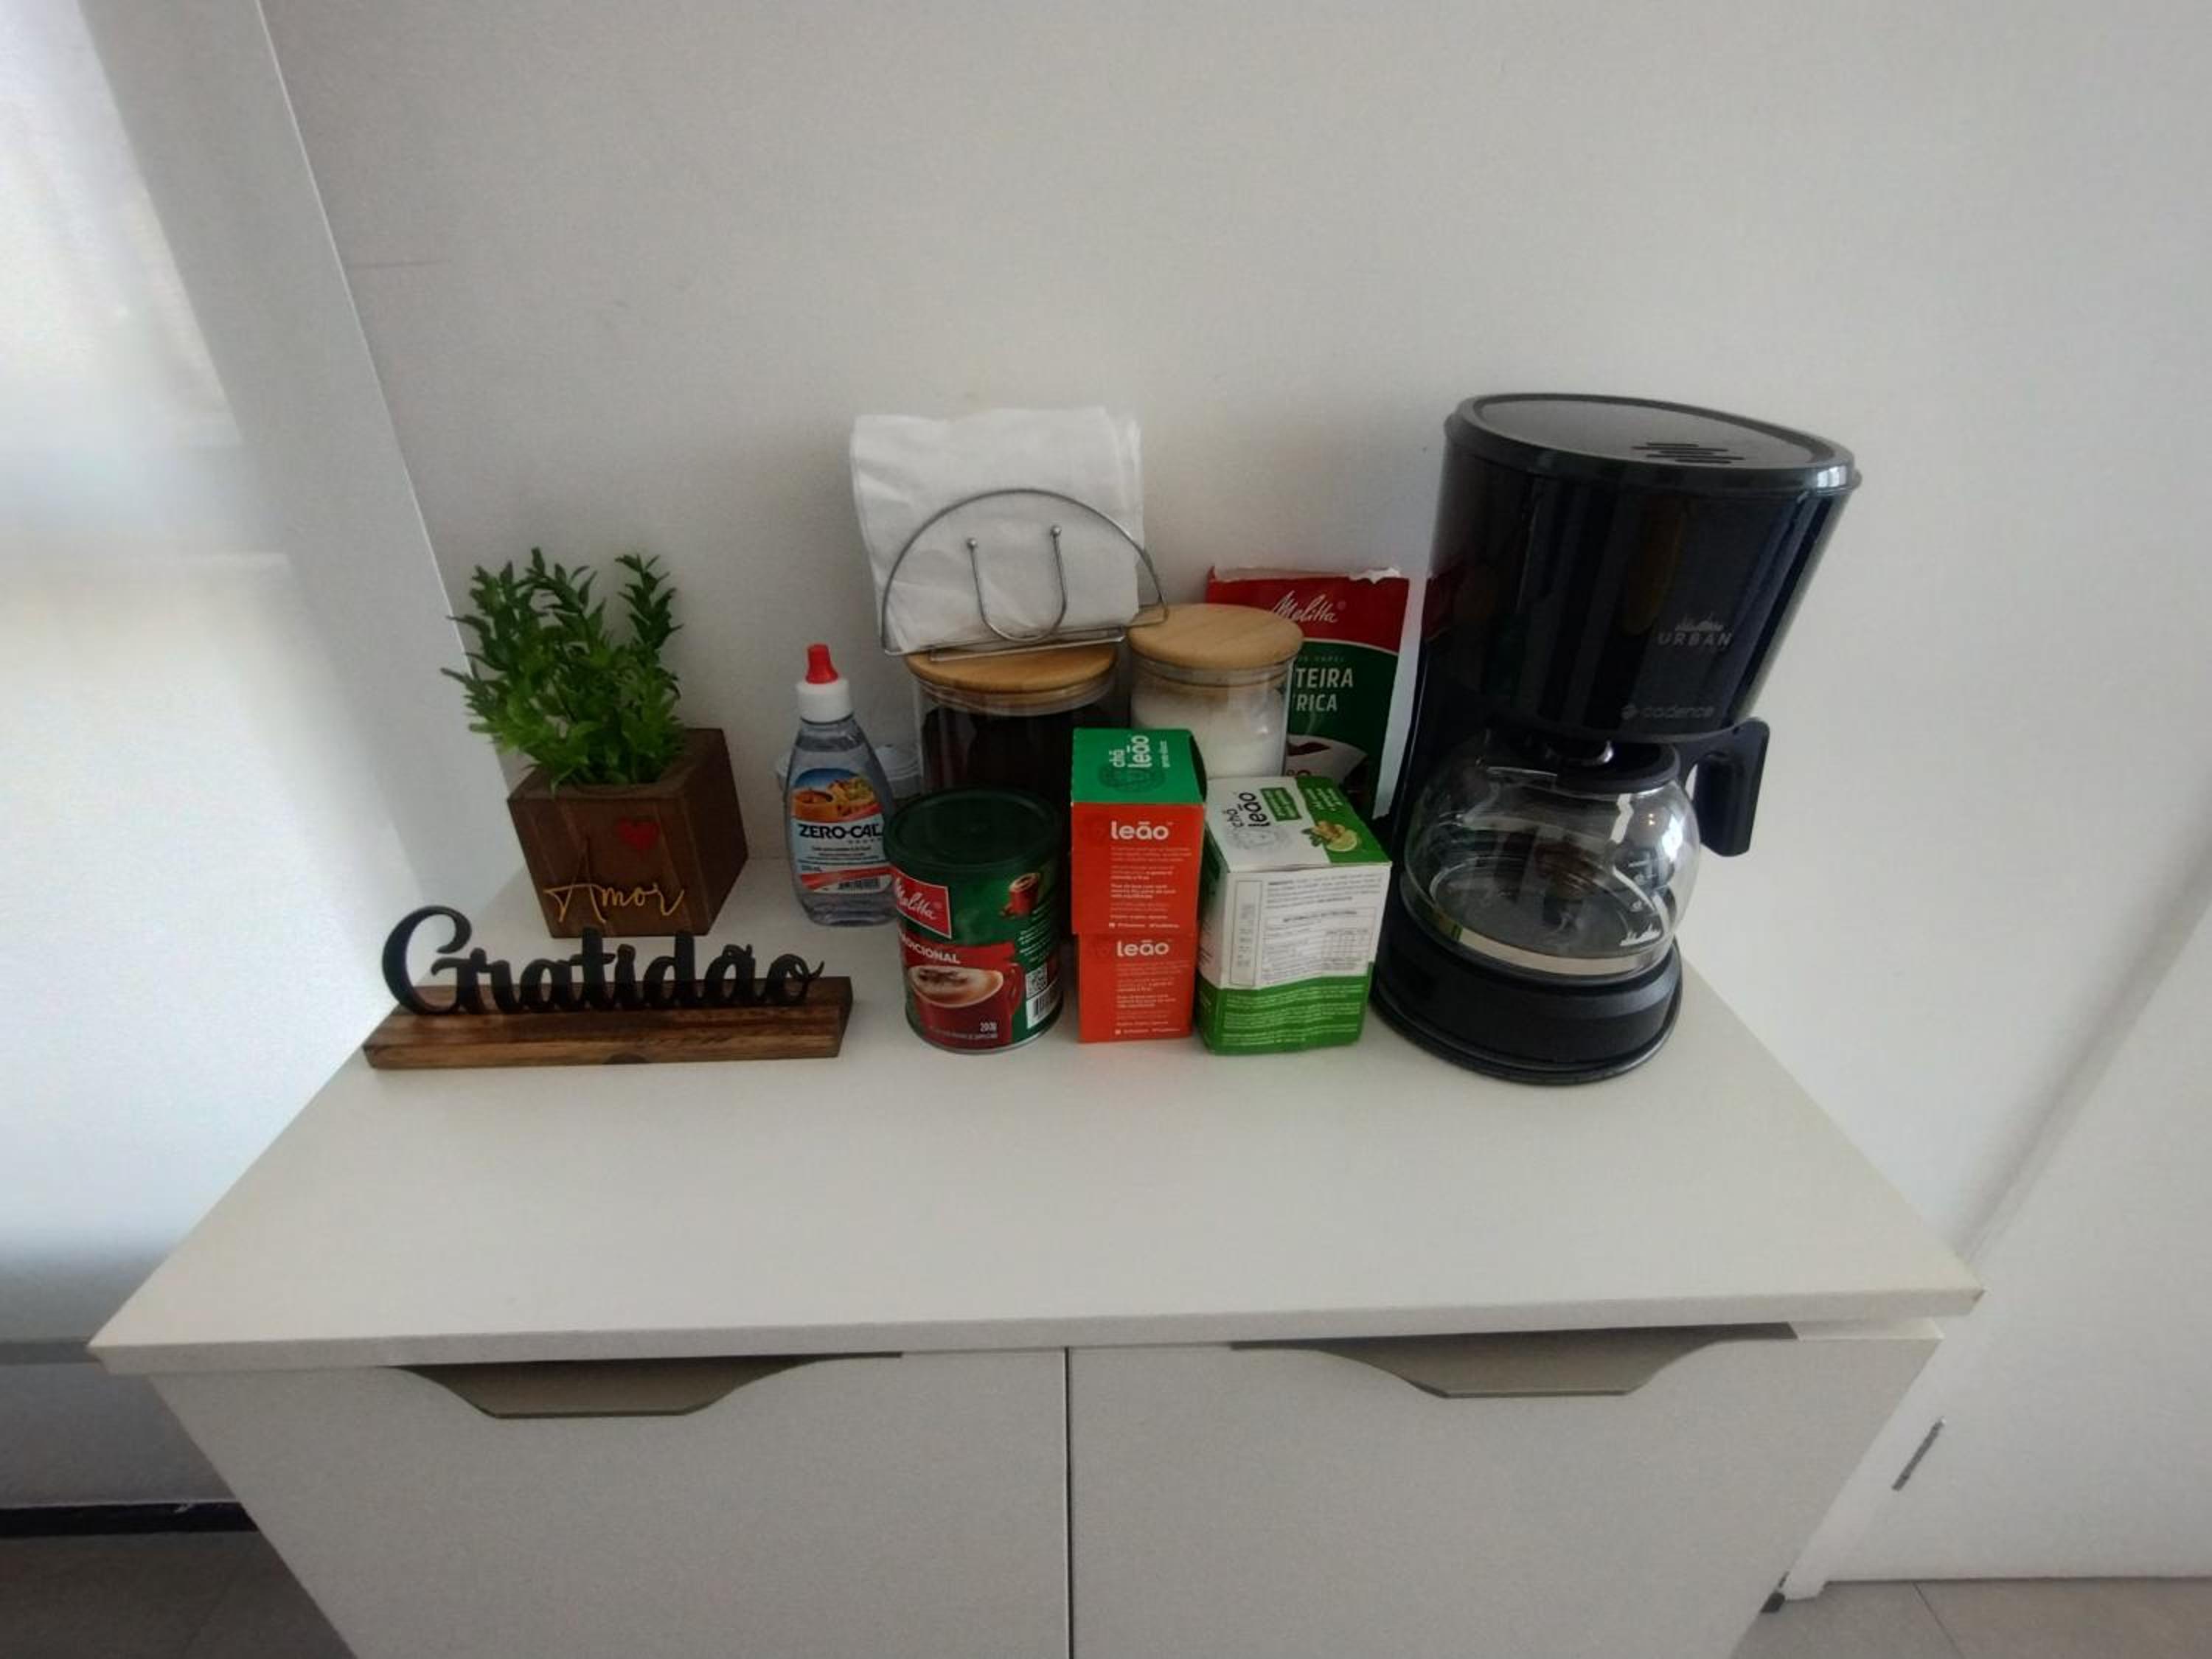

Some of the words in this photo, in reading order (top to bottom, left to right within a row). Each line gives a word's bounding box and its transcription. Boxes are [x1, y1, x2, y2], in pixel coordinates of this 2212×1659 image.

[1273, 590, 1338, 623] Melitta
[1658, 632, 1733, 647] URBAN
[1295, 667, 1354, 689] TEIRA
[1127, 735, 1153, 768] leão
[1237, 791, 1270, 827] leão
[798, 824, 884, 839] ZERO-CAL
[1110, 821, 1169, 840] leão
[543, 882, 685, 924] Amor
[381, 905, 824, 1015] Gratidão
[1116, 939, 1169, 957] leão
